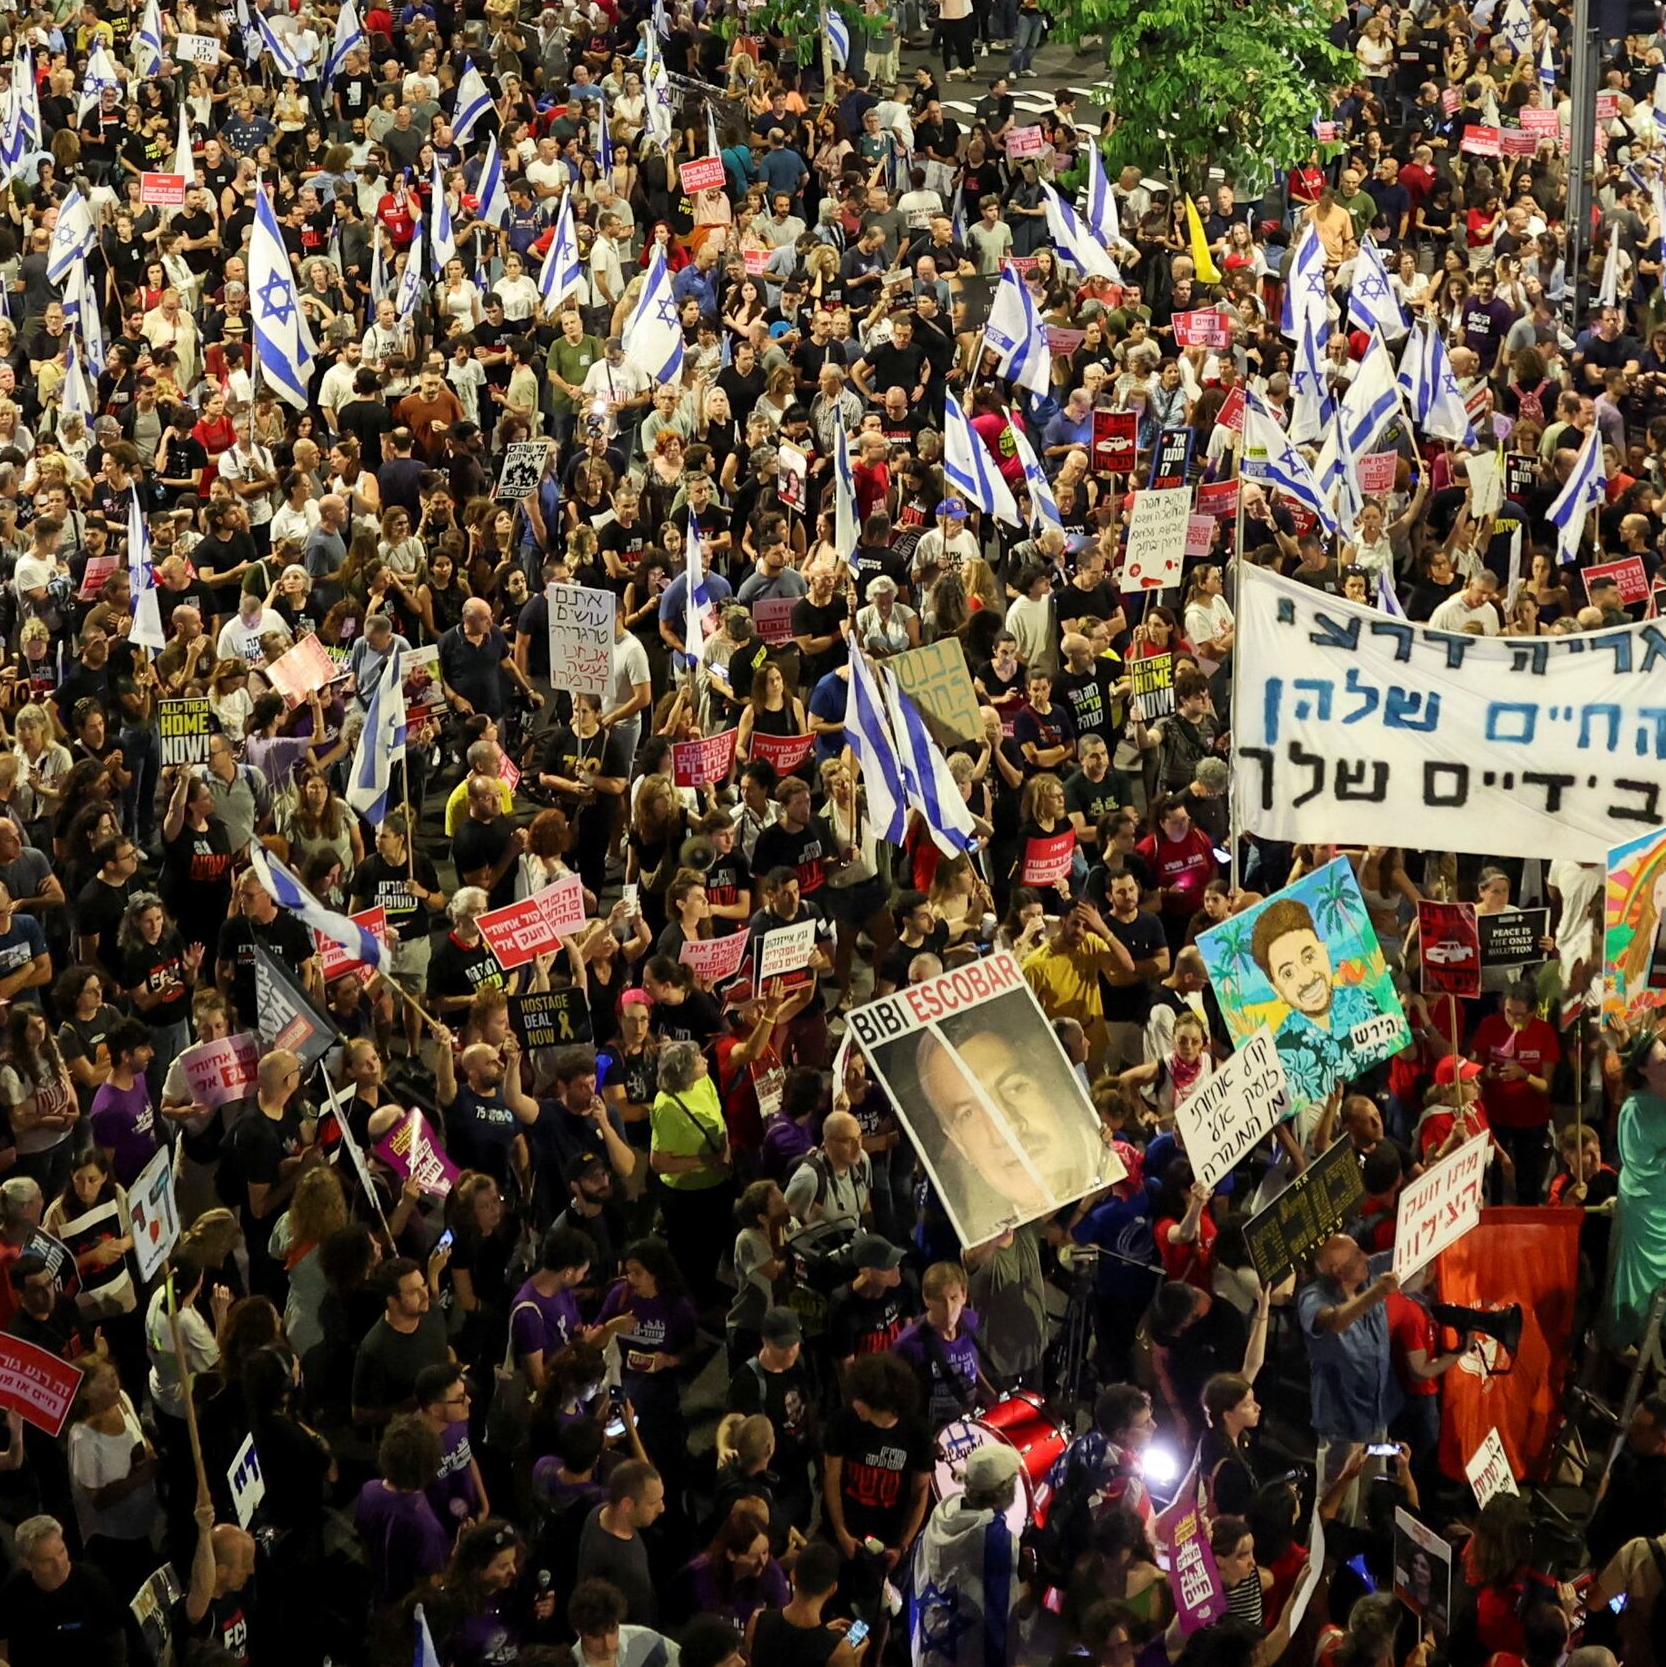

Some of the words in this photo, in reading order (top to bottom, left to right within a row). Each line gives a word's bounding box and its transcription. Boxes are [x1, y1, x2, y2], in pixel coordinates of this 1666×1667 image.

[508, 444, 533, 454] שהרס
[554, 589, 602, 608] אתם
[556, 607, 608, 626] עושים
[561, 645, 608, 662] אנחנו
[565, 660, 608, 674] נעשה
[1135, 669, 1174, 695] HOME
[160, 703, 176, 714] ALL
[184, 699, 210, 712] THEM
[1137, 688, 1176, 721] NOW!
[1264, 667, 1442, 747] שלהן
[160, 713, 208, 736] HOME
[161, 735, 210, 766] NOW!
[1238, 742, 1391, 812] שלך
[1423, 759, 1666, 826] בידיים
[519, 929, 547, 945] זועק
[1488, 938, 1508, 948] THE
[1508, 935, 1533, 947] ONLY
[1492, 927, 1520, 939] PEACE
[1520, 926, 1532, 936] IS
[1487, 944, 1533, 956] SOLUTION
[520, 993, 568, 1013] HOSTAGE
[852, 996, 910, 1046] BIBI
[905, 953, 1024, 1023] ESCOBAR
[524, 1012, 553, 1030] DEAL
[527, 1028, 555, 1047] NOW
[1354, 1019, 1396, 1045] הירש
[1294, 1176, 1311, 1191] את
[24, 1363, 51, 1388] רגע
[28, 1385, 59, 1411] חיים
